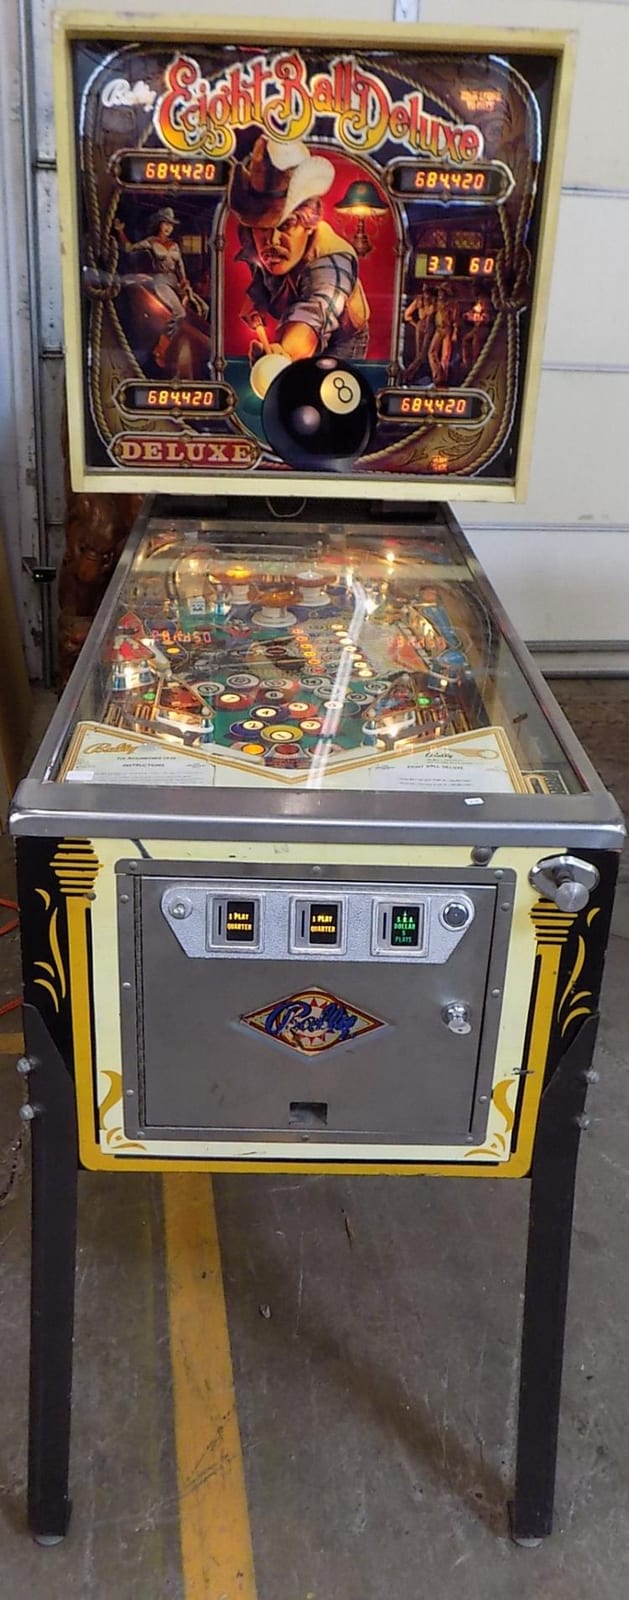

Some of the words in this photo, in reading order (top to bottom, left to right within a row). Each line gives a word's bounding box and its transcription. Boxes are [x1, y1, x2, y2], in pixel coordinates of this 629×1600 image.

[153, 52, 270, 159] Eight
[262, 52, 355, 144] Ball
[335, 68, 485, 165] Deluxe
[469, 256, 494, 274] 60
[333, 377, 354, 404] 8
[120, 441, 251, 463] DELUXE
[83, 742, 137, 755] Bally
[234, 912, 249, 921] PLAY
[317, 915, 333, 923] PLAY
[227, 923, 252, 931] QUARTER
[310, 925, 336, 933] QUARTER
[264, 1001, 357, 1041] Bally
